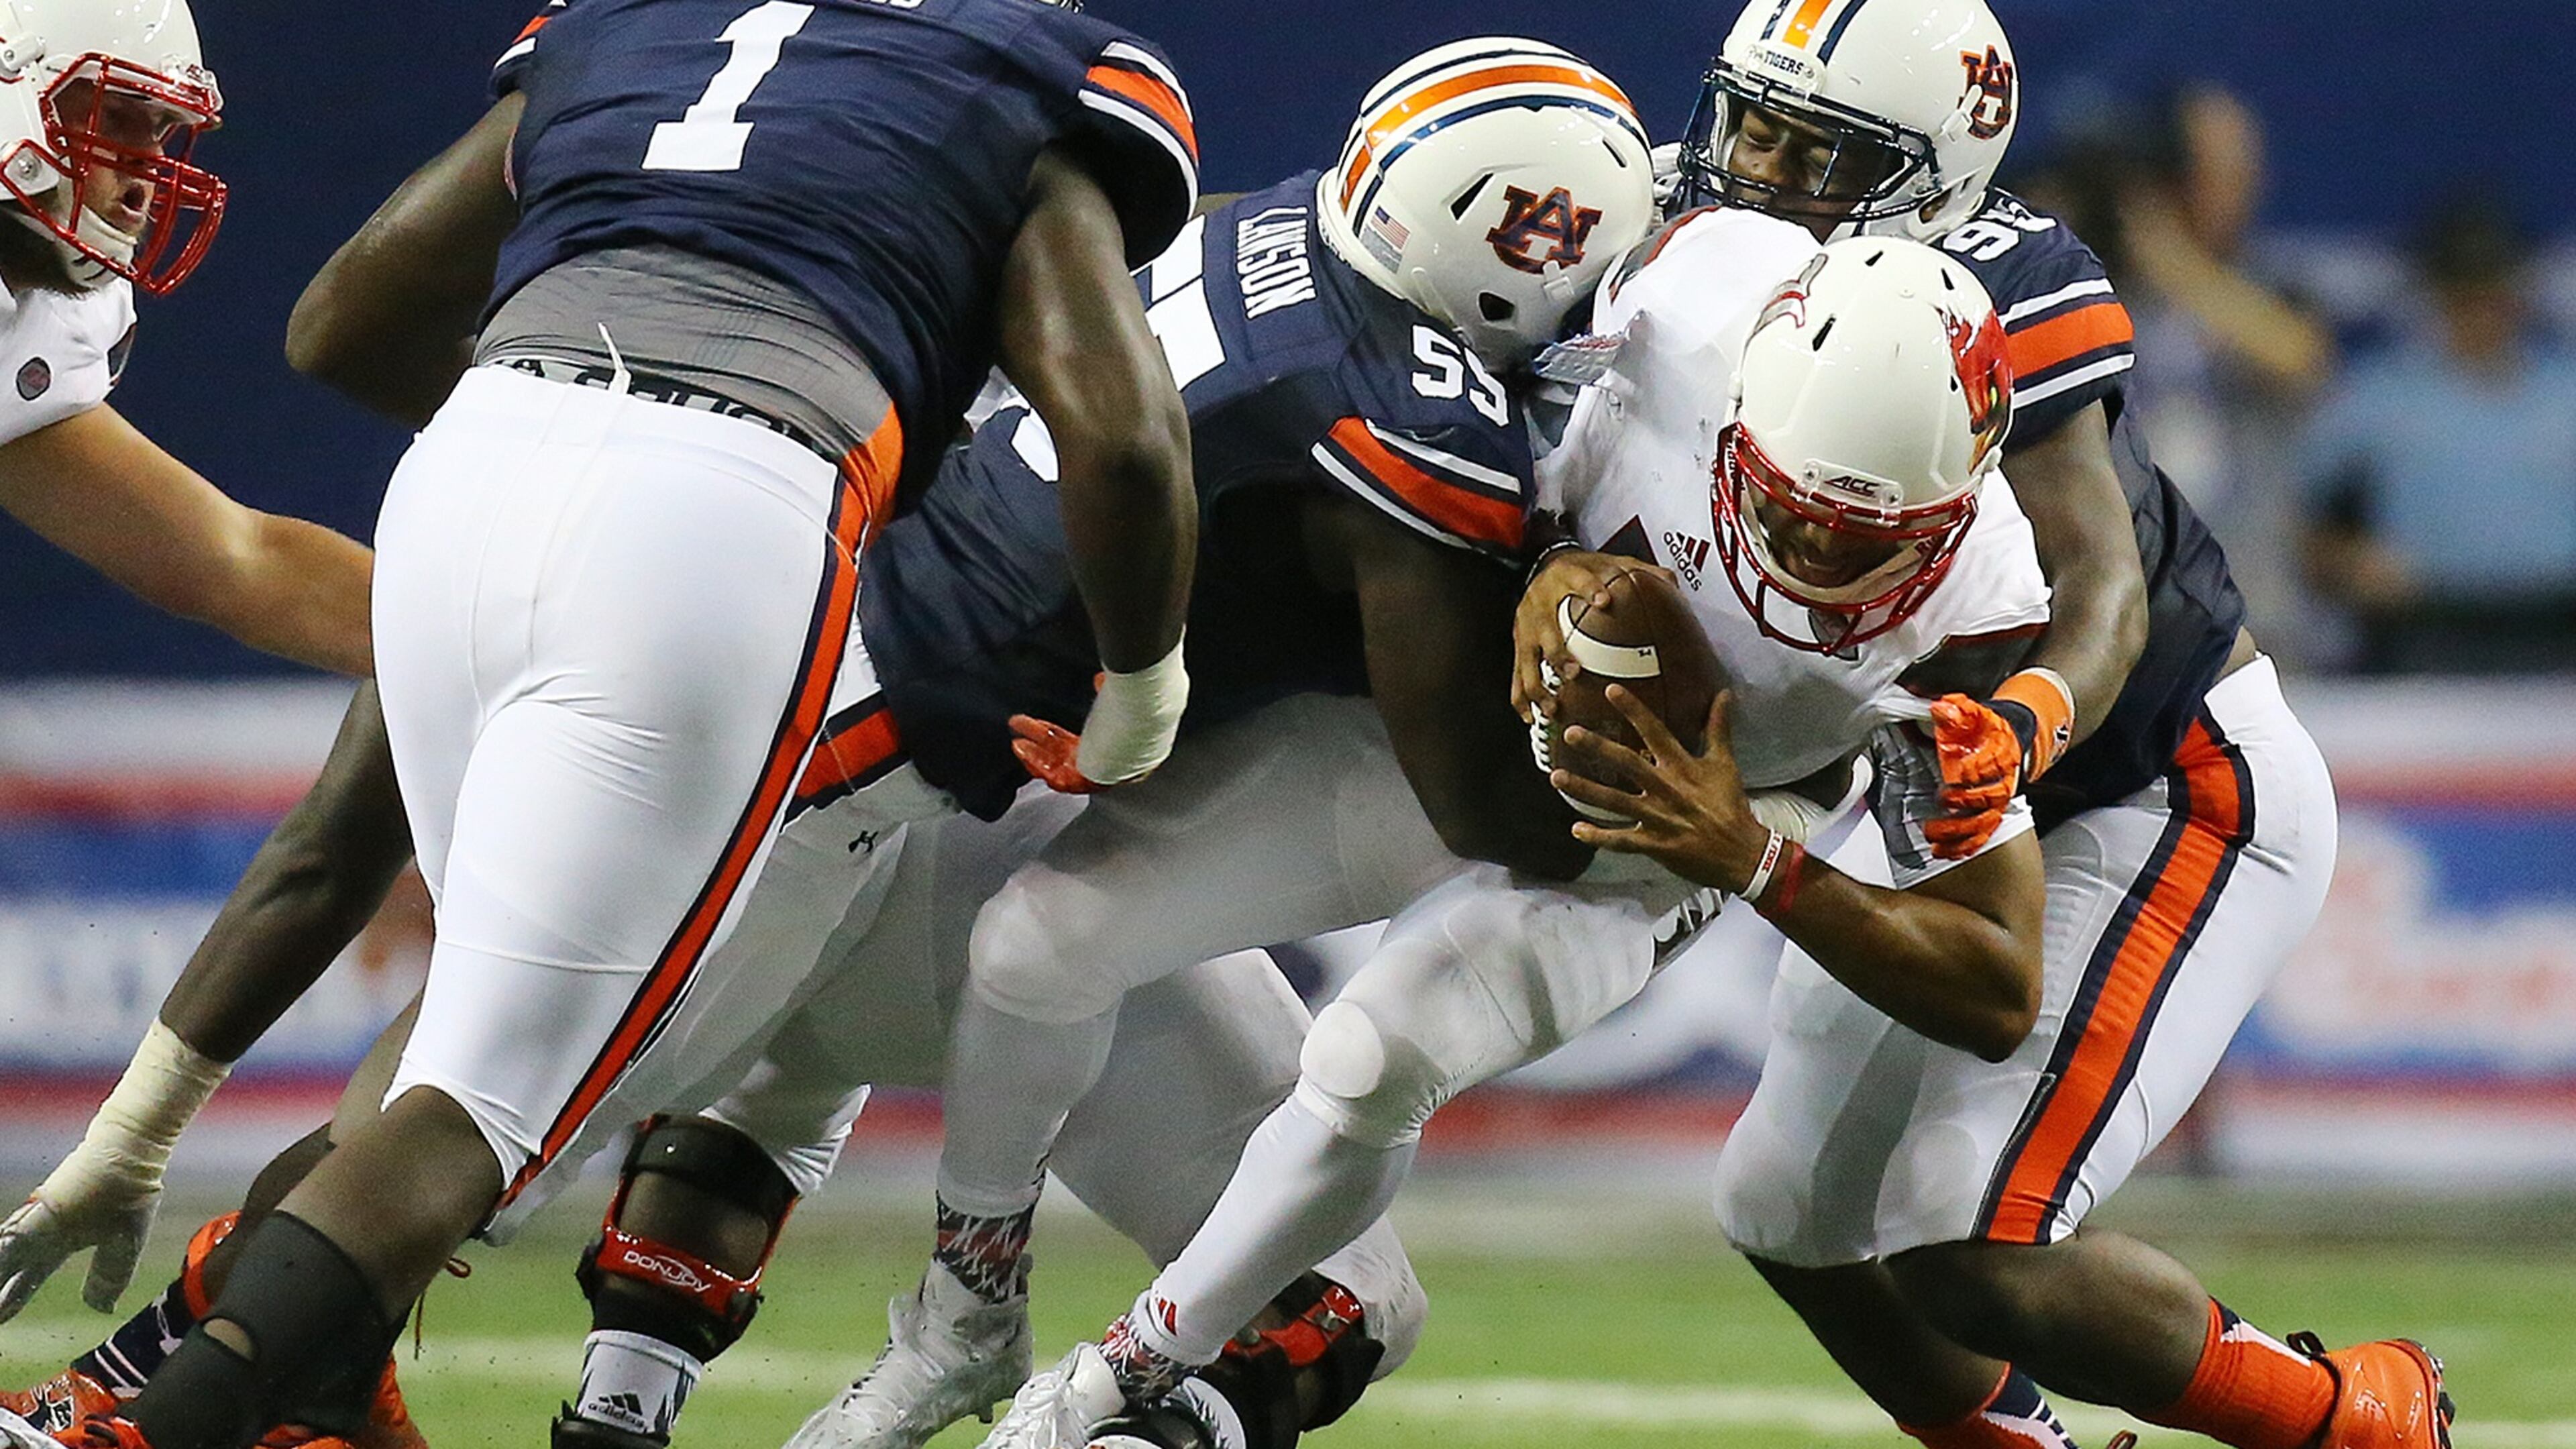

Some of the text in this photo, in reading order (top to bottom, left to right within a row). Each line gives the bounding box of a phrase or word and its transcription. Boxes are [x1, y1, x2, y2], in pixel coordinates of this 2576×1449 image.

[1764, 50, 1804, 75] TIGERS
[642, 0, 815, 170] 1
[1412, 325, 1509, 427] 55
[1823, 475, 1880, 498] ACC
[1664, 531, 1702, 591] adidas
[624, 1250, 711, 1291] DONJOY
[588, 1402, 644, 1428] adidas
